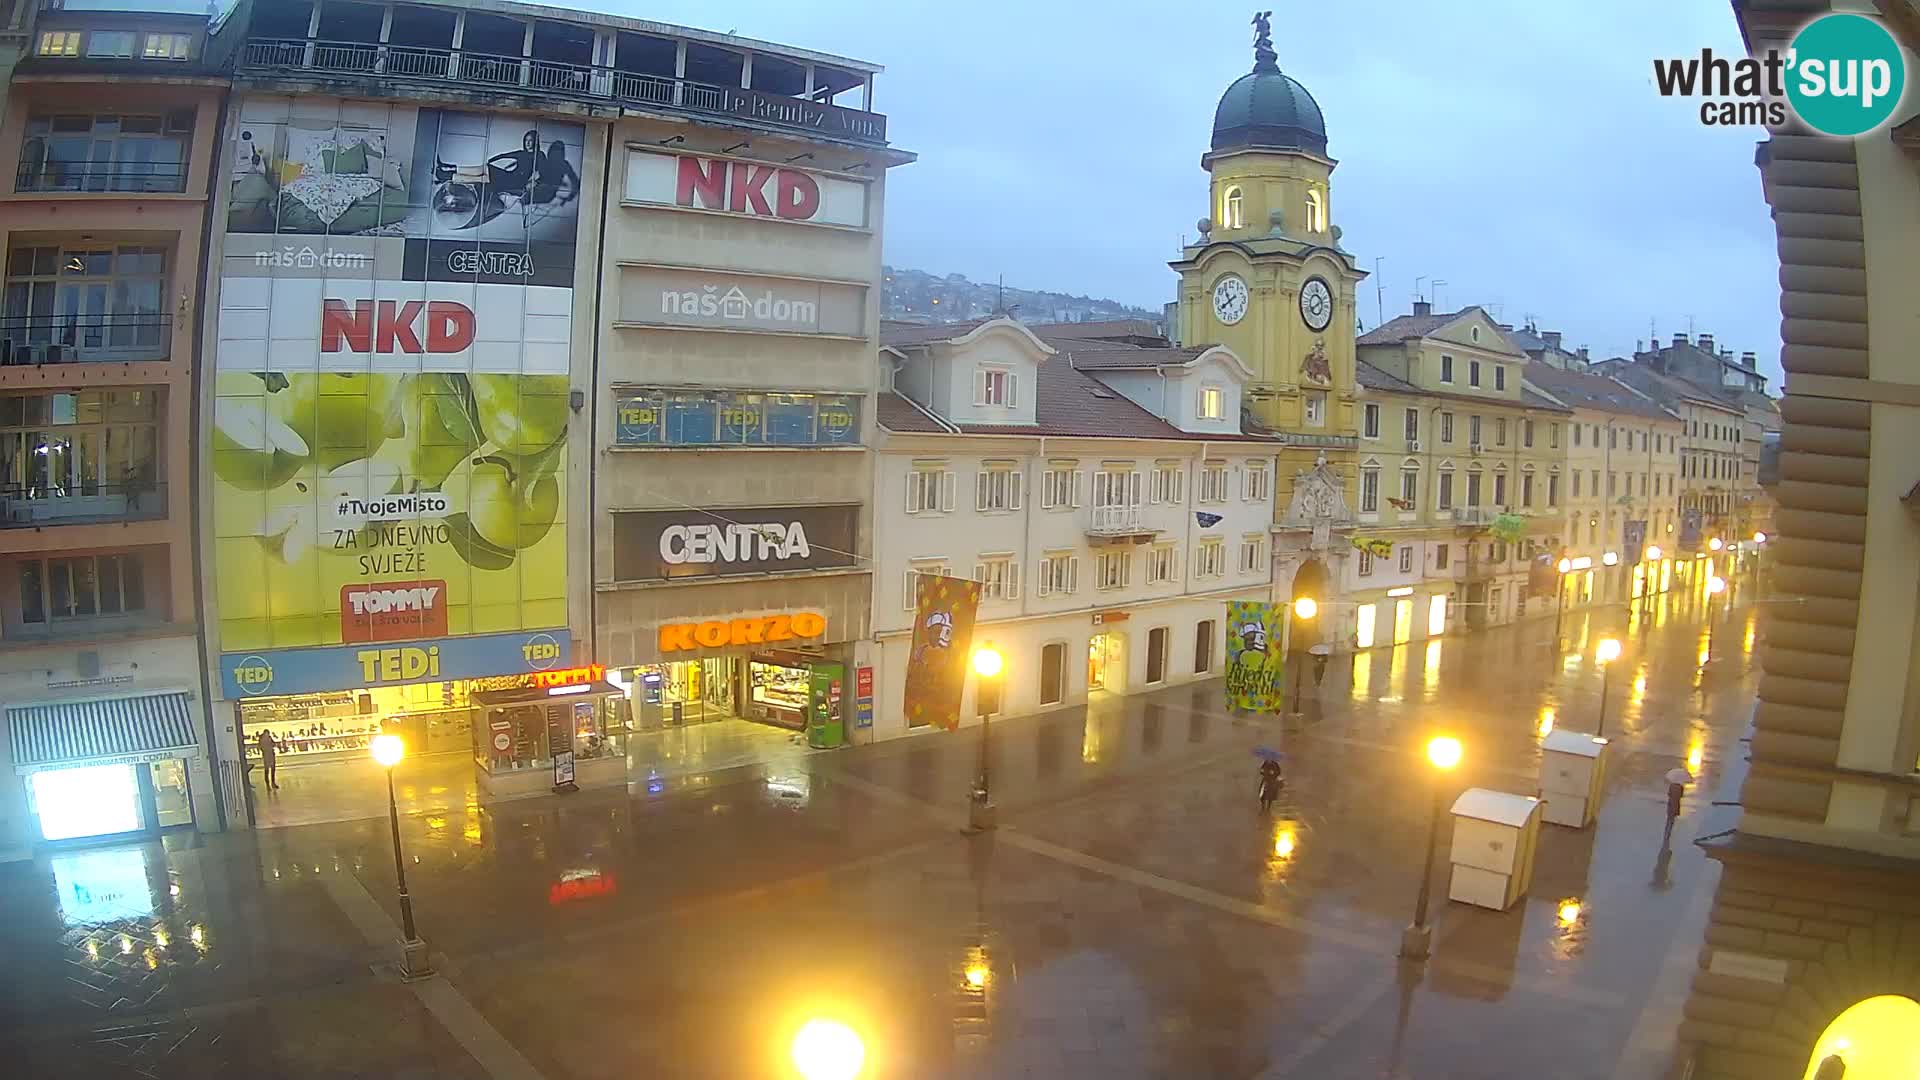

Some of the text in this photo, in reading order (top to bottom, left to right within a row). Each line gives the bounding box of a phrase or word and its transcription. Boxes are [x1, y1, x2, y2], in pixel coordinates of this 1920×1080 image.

[723, 89, 745, 112] Le
[752, 94, 824, 128] Rendez
[676, 156, 820, 220] NKD
[255, 246, 365, 270] naš dom
[448, 250, 534, 276] CENTRA
[661, 284, 817, 324] naš dom
[320, 298, 477, 354] NKD
[620, 408, 657, 426] TEDi
[722, 410, 759, 427] TEDi
[820, 411, 853, 427] TEDi
[338, 497, 446, 517] #TvojeMisto
[334, 524, 450, 550] ZA DNEVNO
[659, 521, 811, 565] CENTRA
[360, 548, 426, 576] SVJEŽE
[348, 587, 439, 615] TOMMY
[659, 612, 826, 652] KORZO
[358, 646, 441, 683] TEDi
[522, 643, 560, 662] TEDi
[233, 665, 273, 685] TEDi
